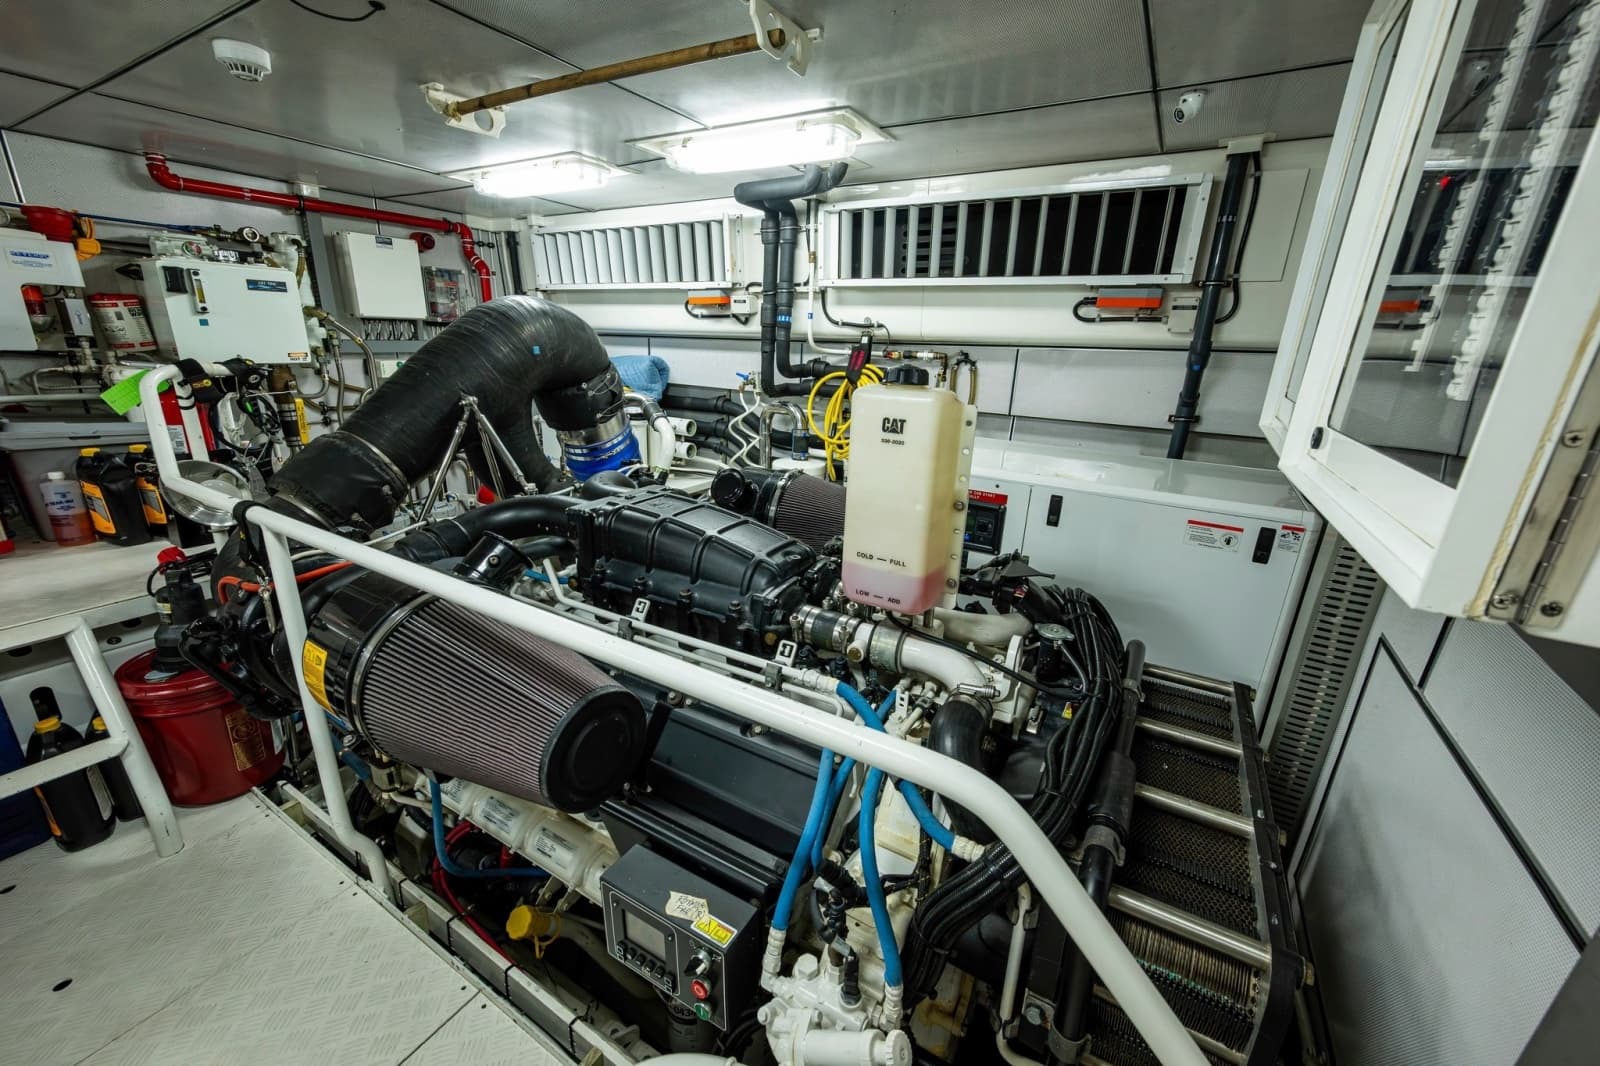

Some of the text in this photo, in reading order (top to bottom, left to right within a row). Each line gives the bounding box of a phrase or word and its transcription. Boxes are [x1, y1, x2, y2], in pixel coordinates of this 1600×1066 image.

[882, 417, 906, 434] CAT
[856, 551, 907, 567] COLD FULL
[855, 588, 901, 605] LOW ADD
